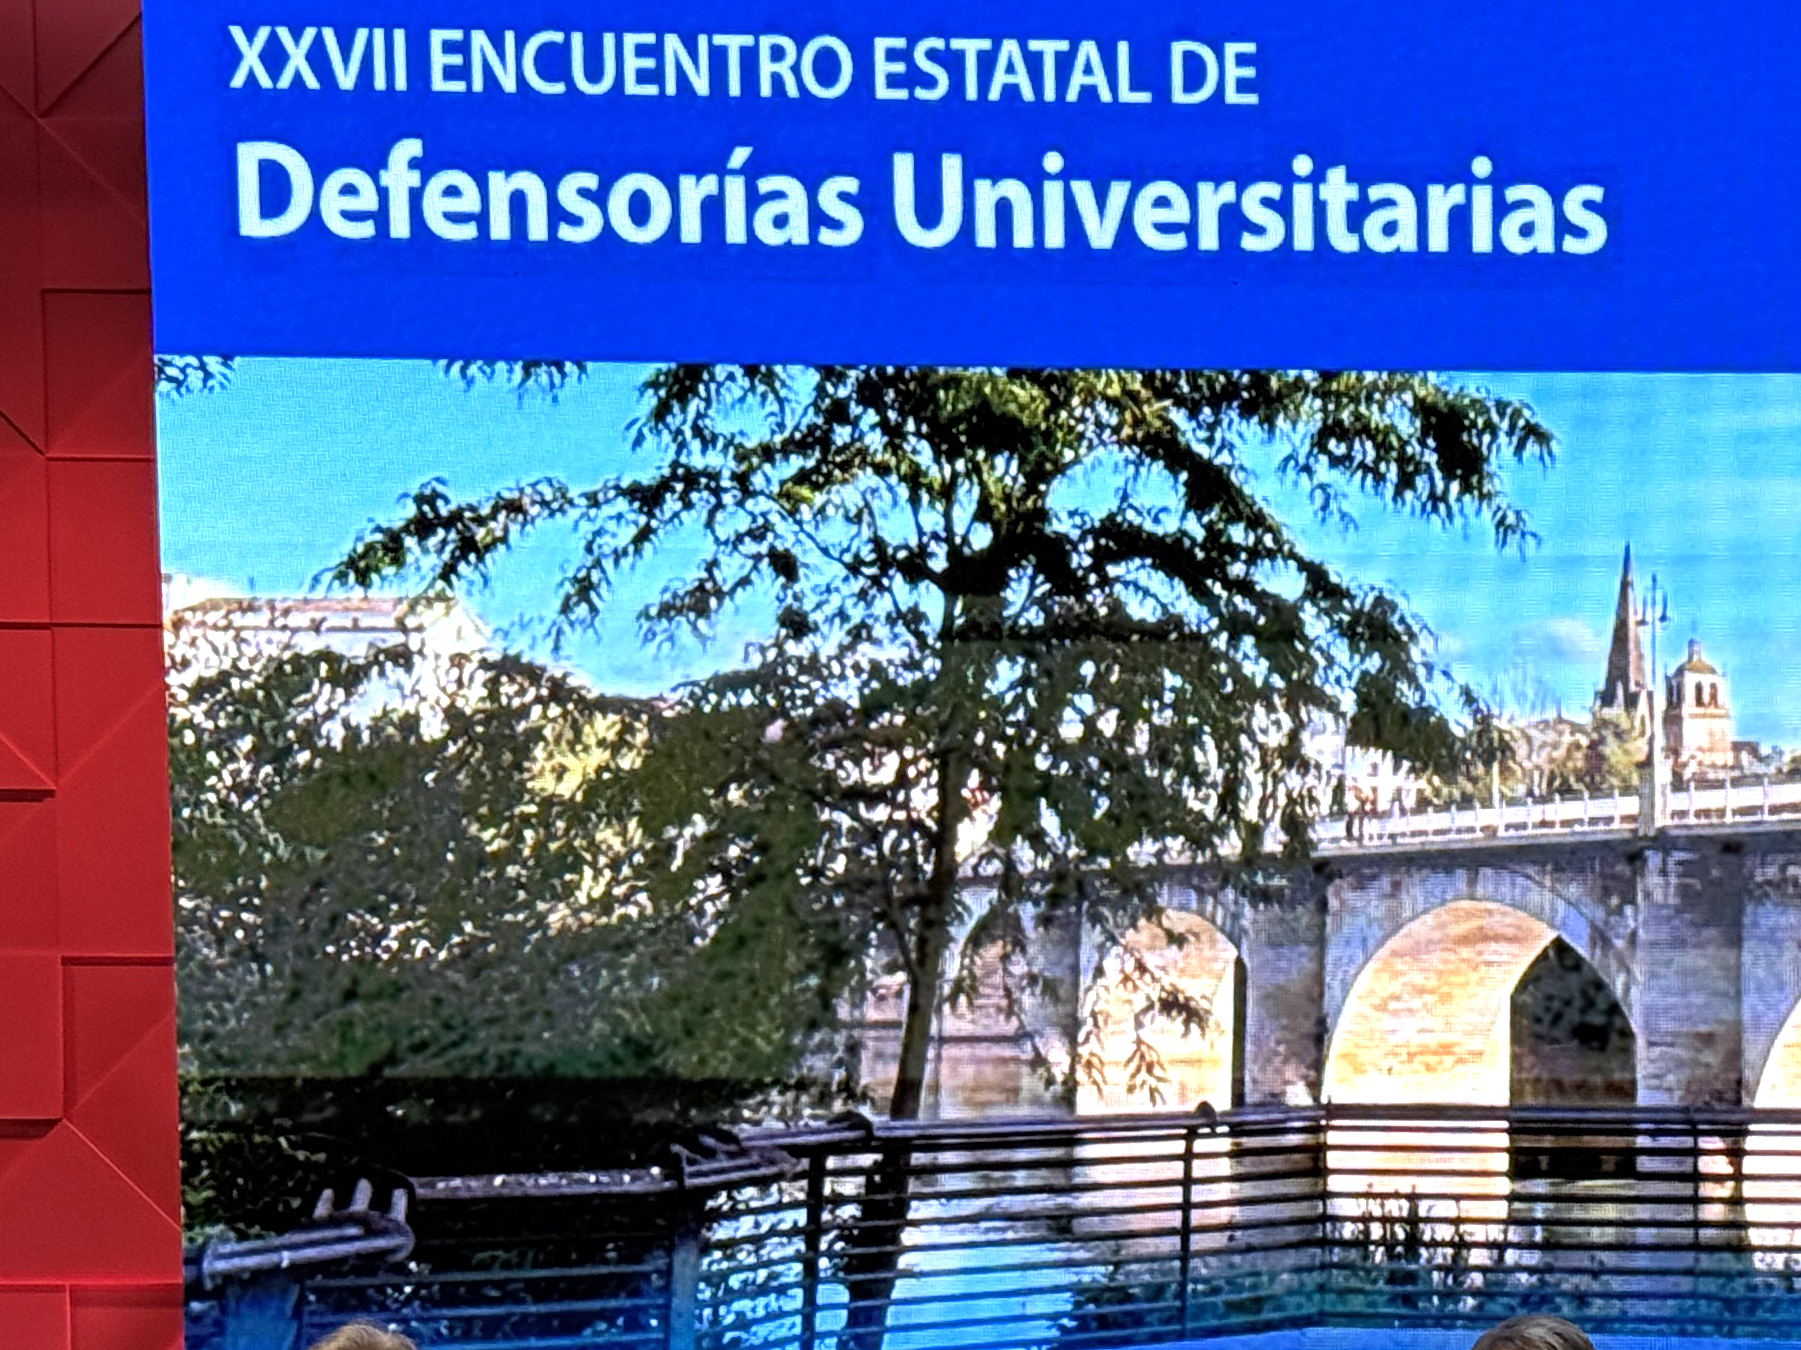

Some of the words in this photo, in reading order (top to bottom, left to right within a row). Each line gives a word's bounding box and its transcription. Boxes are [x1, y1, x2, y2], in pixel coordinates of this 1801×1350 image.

[229, 26, 406, 90] XXVII
[430, 29, 852, 98] ENCUENTRO
[874, 37, 1151, 103] ESTATAL
[1172, 41, 1258, 104] DE
[238, 138, 863, 246] Defensorías
[894, 152, 1607, 254] Universitarias
